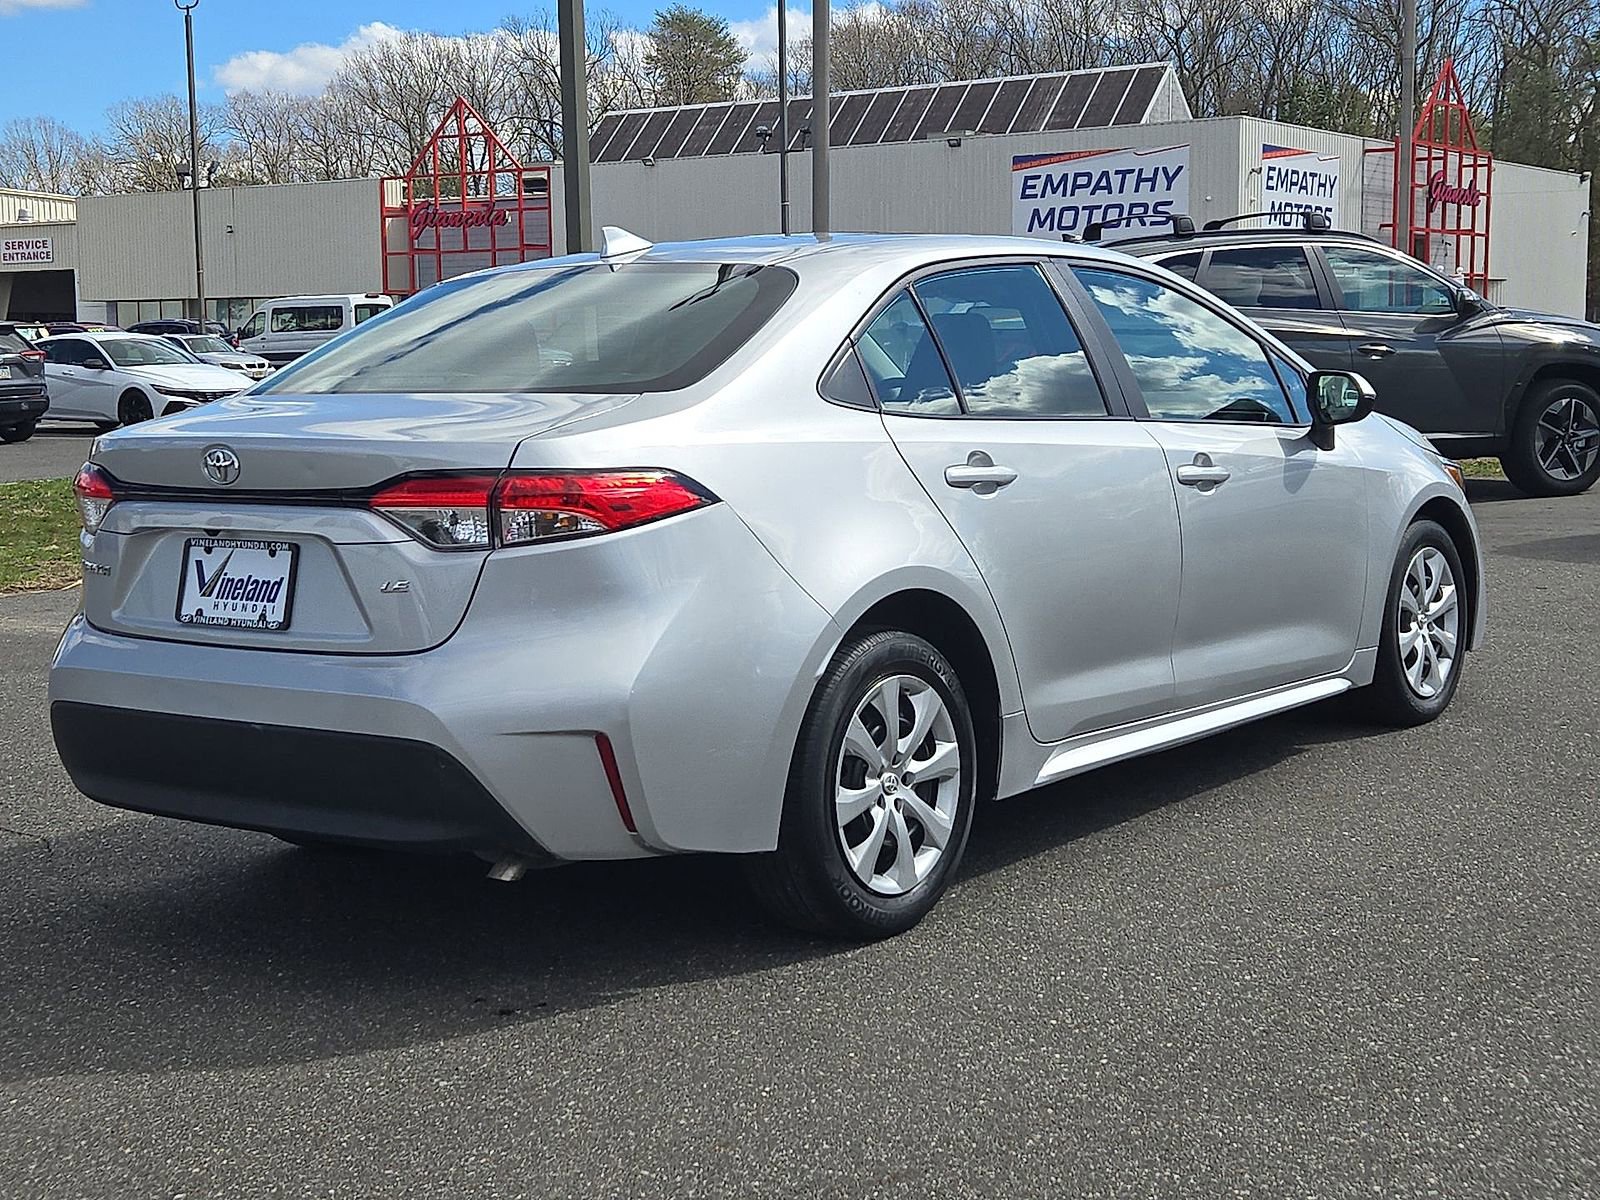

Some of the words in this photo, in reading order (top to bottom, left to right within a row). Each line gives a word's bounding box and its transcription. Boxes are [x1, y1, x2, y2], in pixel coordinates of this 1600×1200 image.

[1020, 165, 1184, 200] EMPATHY
[1265, 165, 1338, 198] EMPATHY
[1027, 200, 1174, 233] MOTORS
[4, 240, 49, 250] SERVICE
[2, 251, 52, 261] ENTRANCE
[190, 538, 290, 551] VINELANDHYUNDAI.COM
[194, 548, 285, 604] Vineland
[380, 579, 410, 593] LE
[213, 601, 276, 615] HYUNDAI
[193, 615, 229, 626] VINELAND
[231, 617, 267, 629] HYUNDAI
